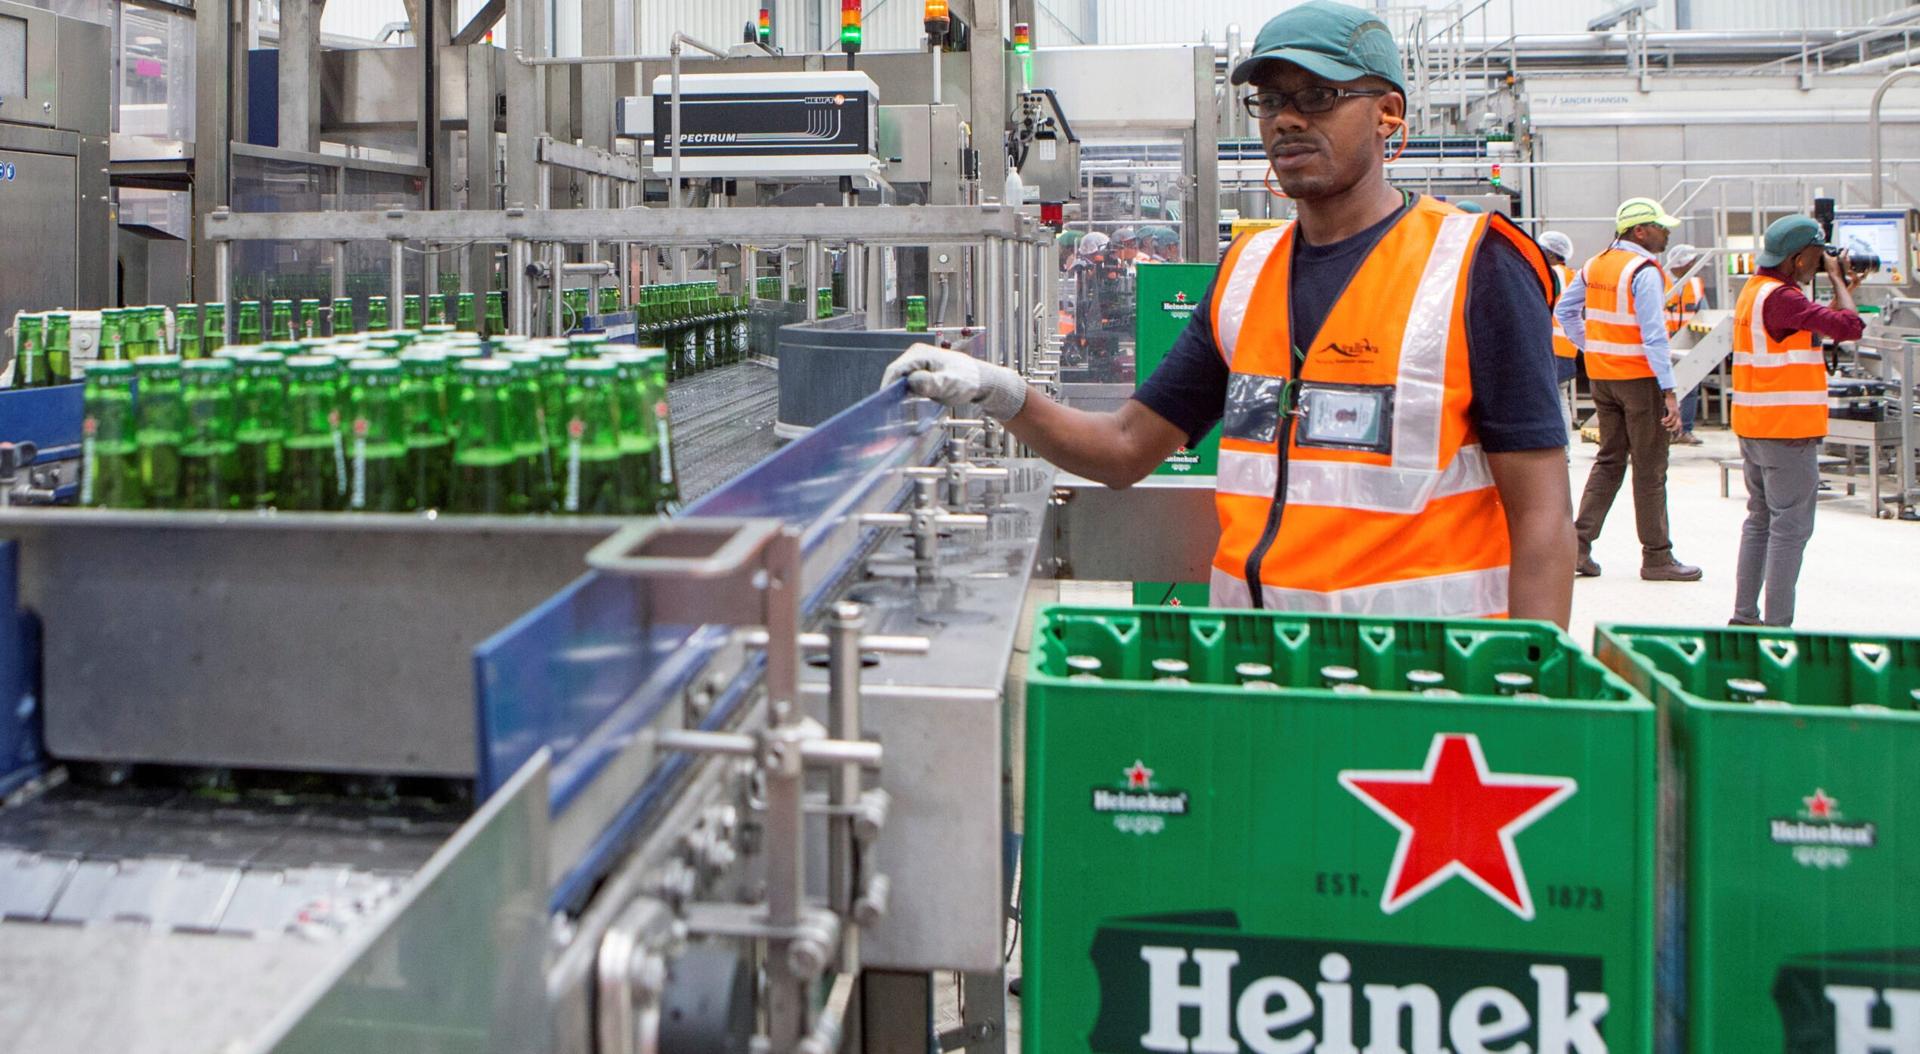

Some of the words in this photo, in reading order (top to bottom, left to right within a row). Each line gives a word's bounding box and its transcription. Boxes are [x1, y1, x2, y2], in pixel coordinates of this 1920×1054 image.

[804, 96, 834, 105] HEUFT
[1560, 96, 1592, 104] SANDER
[1595, 96, 1628, 104] HANSEN
[672, 133, 737, 144] PECTRUM
[1165, 455, 1198, 463] eineken
[1093, 789, 1186, 813] Heineken
[1315, 872, 1370, 897] EST.
[1547, 884, 1604, 911] 1873
